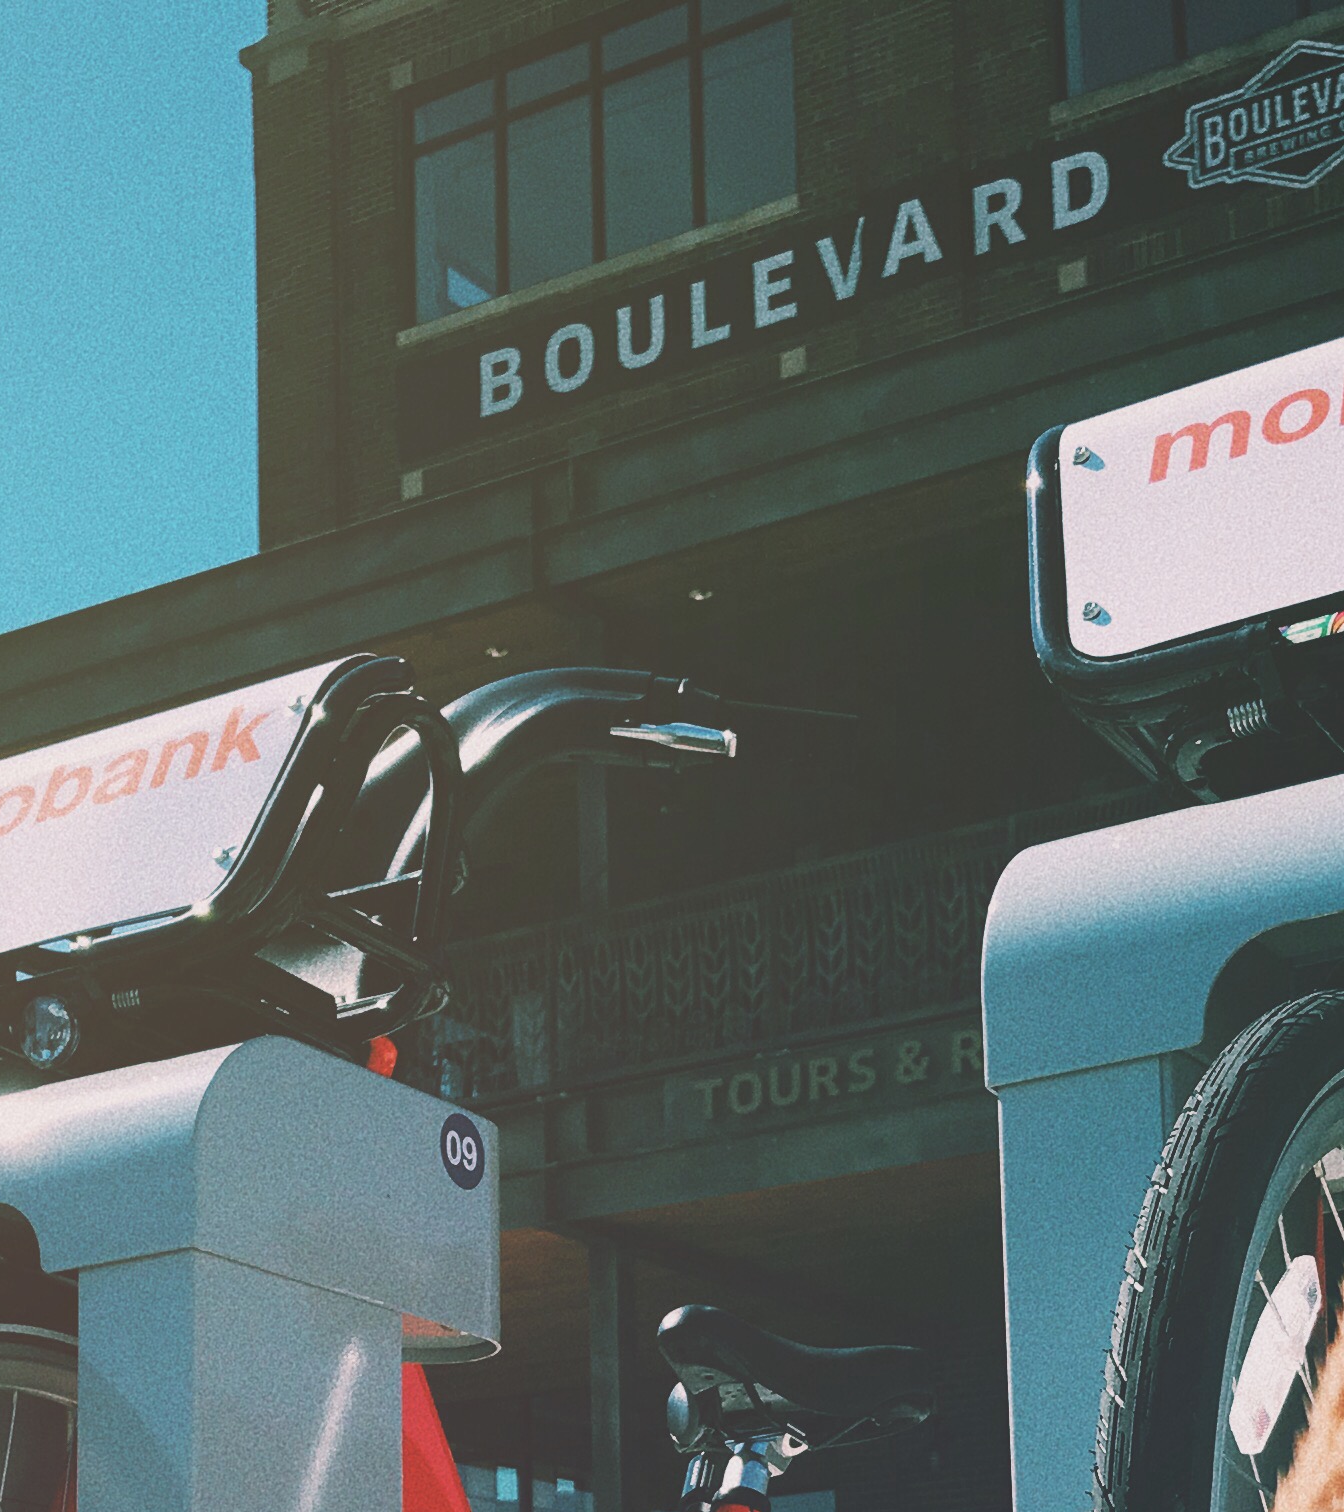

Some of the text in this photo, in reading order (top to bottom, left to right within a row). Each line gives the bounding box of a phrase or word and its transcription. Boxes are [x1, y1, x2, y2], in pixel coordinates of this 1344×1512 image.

[1244, 124, 1332, 163] BREWING
[479, 151, 1110, 418] BOULEVARD
[694, 1048, 876, 1119] TOURS
[894, 1040, 929, 1084] &
[446, 1130, 477, 1171] 09
